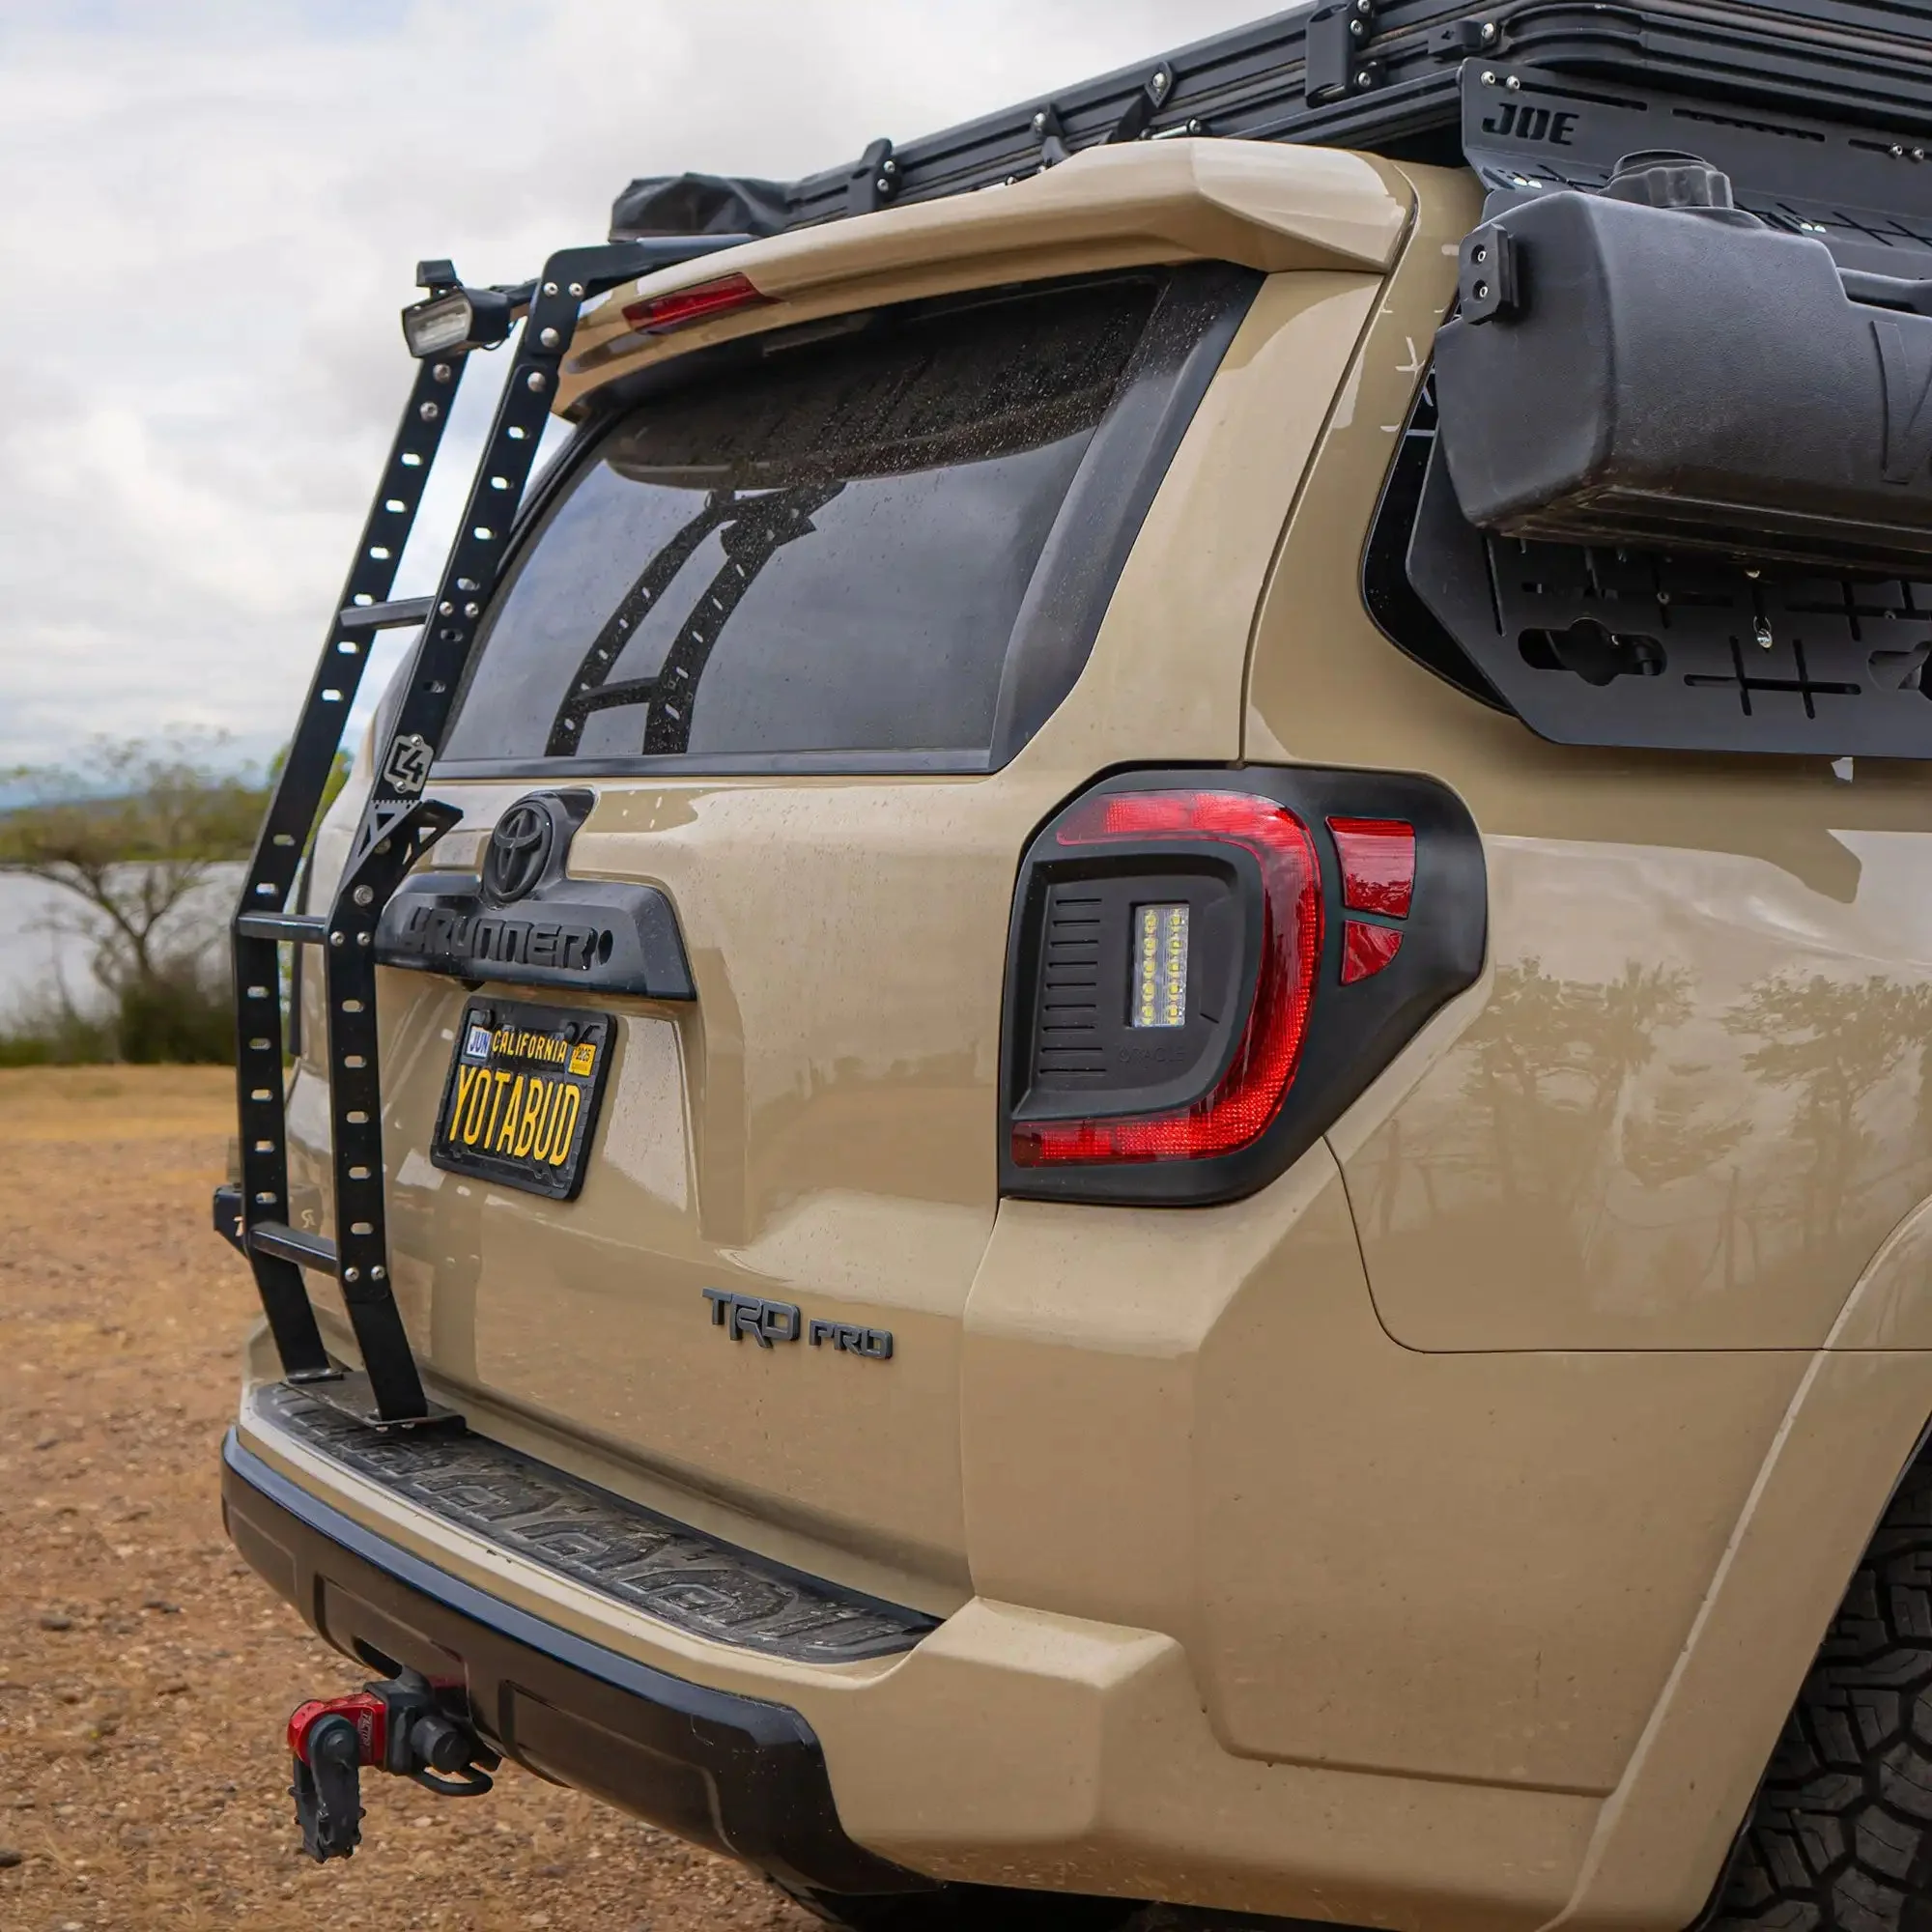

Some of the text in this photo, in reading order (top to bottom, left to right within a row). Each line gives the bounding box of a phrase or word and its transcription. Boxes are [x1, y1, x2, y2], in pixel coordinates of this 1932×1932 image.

[1481, 101, 1580, 146] JOE
[400, 905, 600, 971] 4RUNNER
[469, 1030, 491, 1055] JUN
[491, 1029, 569, 1065] CALIFORNIA
[449, 1064, 581, 1167] YOTABUD
[700, 1286, 894, 1360] TRD PRO
